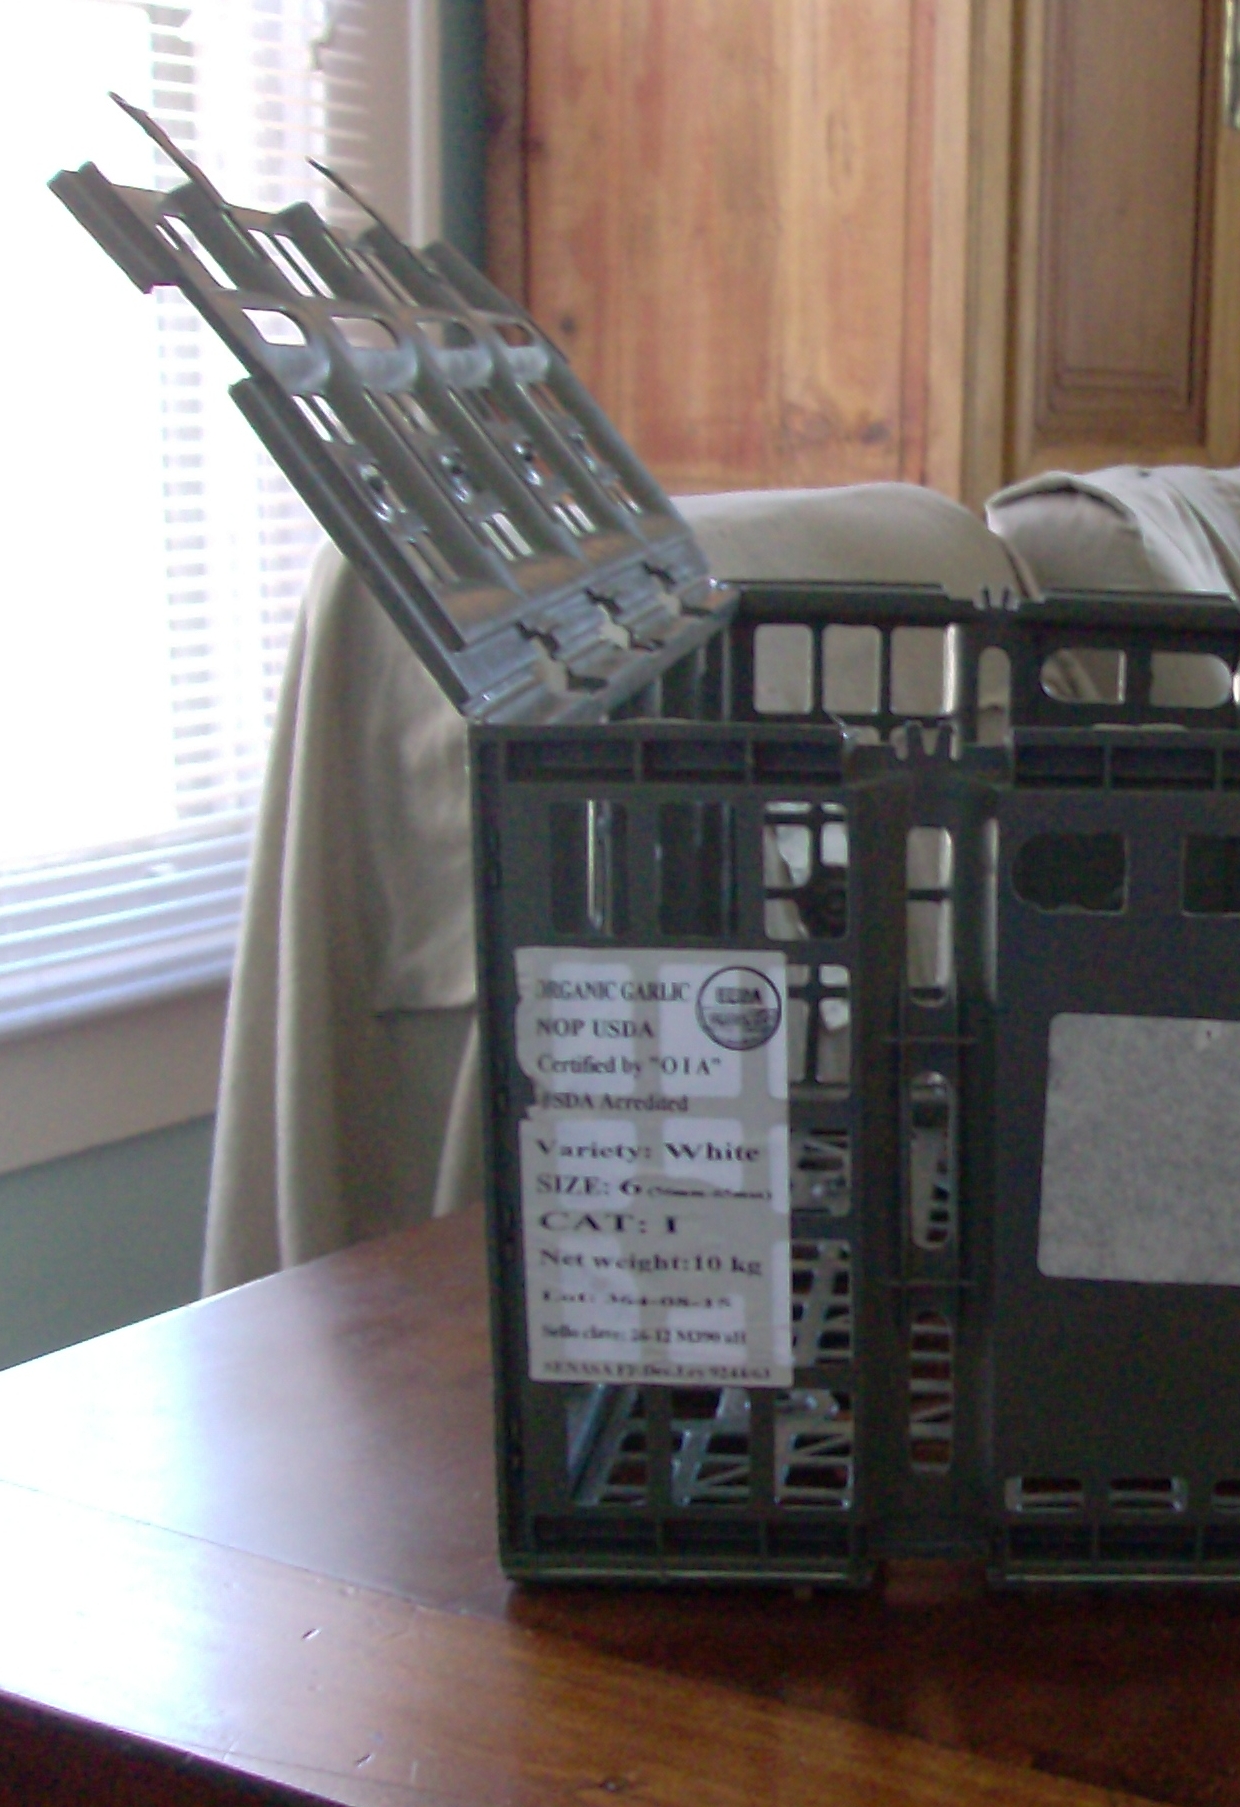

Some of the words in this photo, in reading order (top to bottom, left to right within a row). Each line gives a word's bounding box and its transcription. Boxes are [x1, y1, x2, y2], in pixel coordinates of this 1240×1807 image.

[621, 981, 691, 1001] GARLIC
[537, 1018, 585, 1038] NOP
[592, 1020, 656, 1039] USDA
[537, 1055, 616, 1075] Certified
[621, 1055, 642, 1078] by
[536, 1139, 652, 1163] Variety:
[663, 1141, 762, 1162] White
[536, 1175, 611, 1196] SIZE:
[619, 1177, 643, 1197] 6
[539, 1212, 648, 1234] CAT:
[539, 1248, 584, 1268] Net
[731, 1255, 763, 1276] kg
